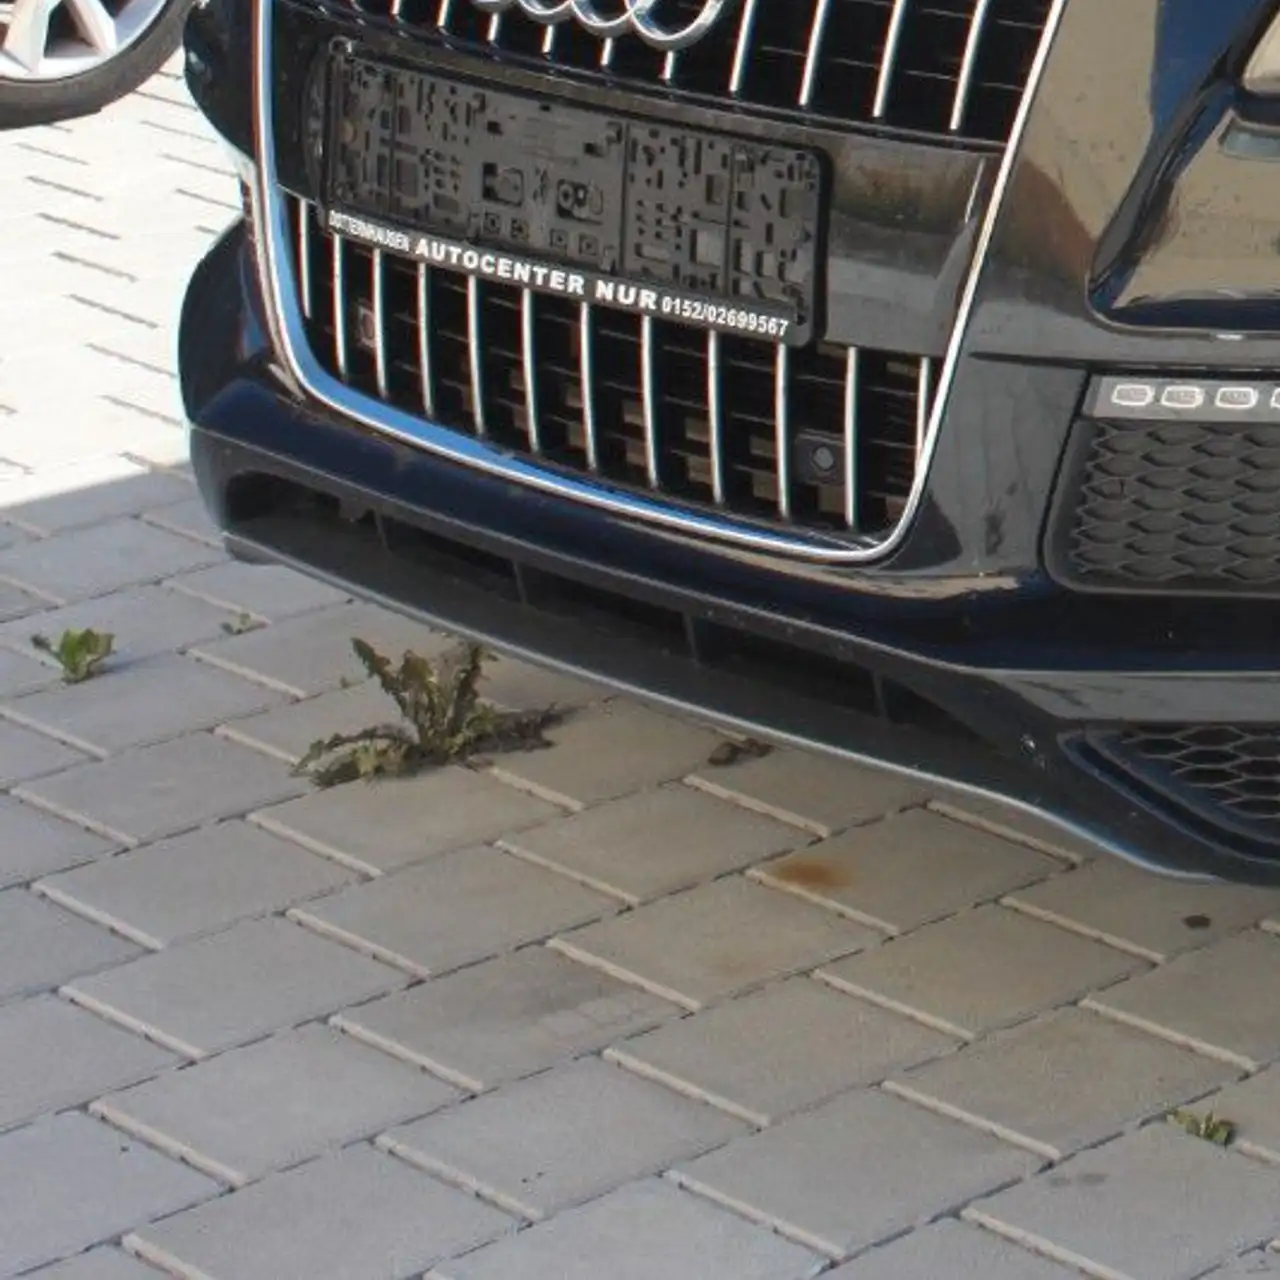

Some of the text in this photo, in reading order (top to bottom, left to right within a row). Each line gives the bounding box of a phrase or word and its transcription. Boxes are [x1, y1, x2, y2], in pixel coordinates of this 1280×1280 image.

[415, 238, 585, 296] AUTOCENTER
[595, 279, 657, 310] NUR
[661, 296, 789, 337] 0152/02699567
